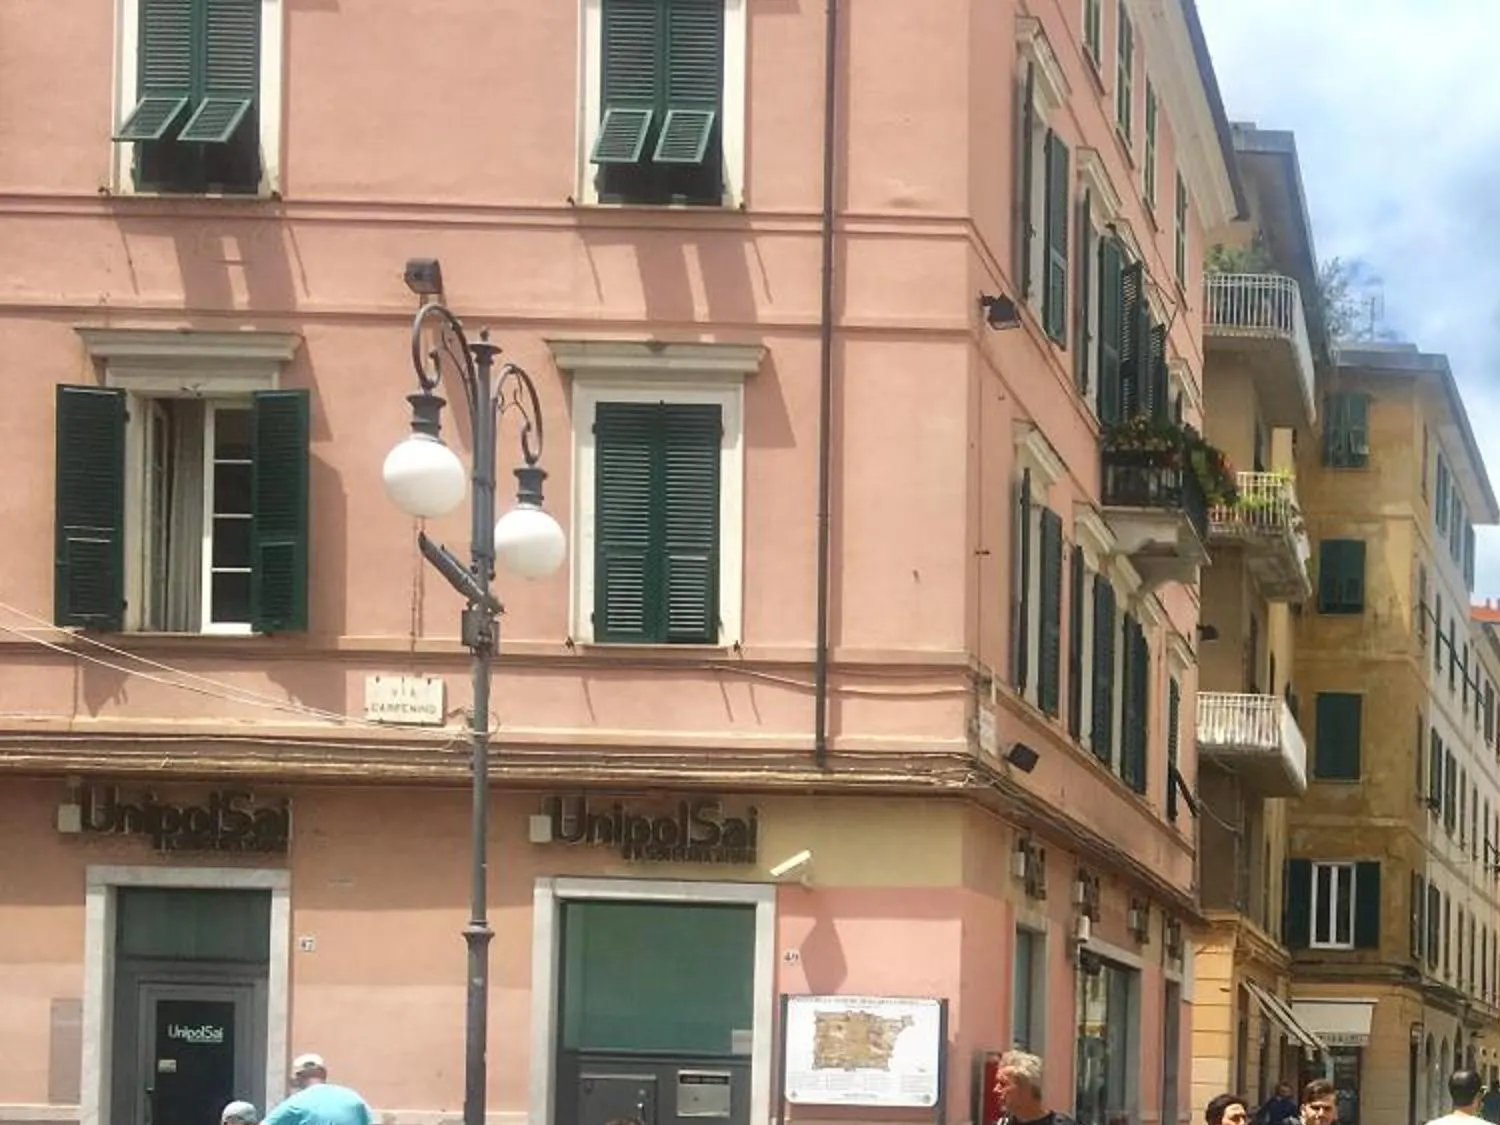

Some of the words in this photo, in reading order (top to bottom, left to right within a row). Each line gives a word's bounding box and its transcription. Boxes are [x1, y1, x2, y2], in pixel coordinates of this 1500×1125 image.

[392, 687, 416, 698] VIA
[82, 784, 293, 851] UnipolSai
[550, 794, 759, 860] UnipolSai
[167, 1023, 224, 1041] UnipolSai
